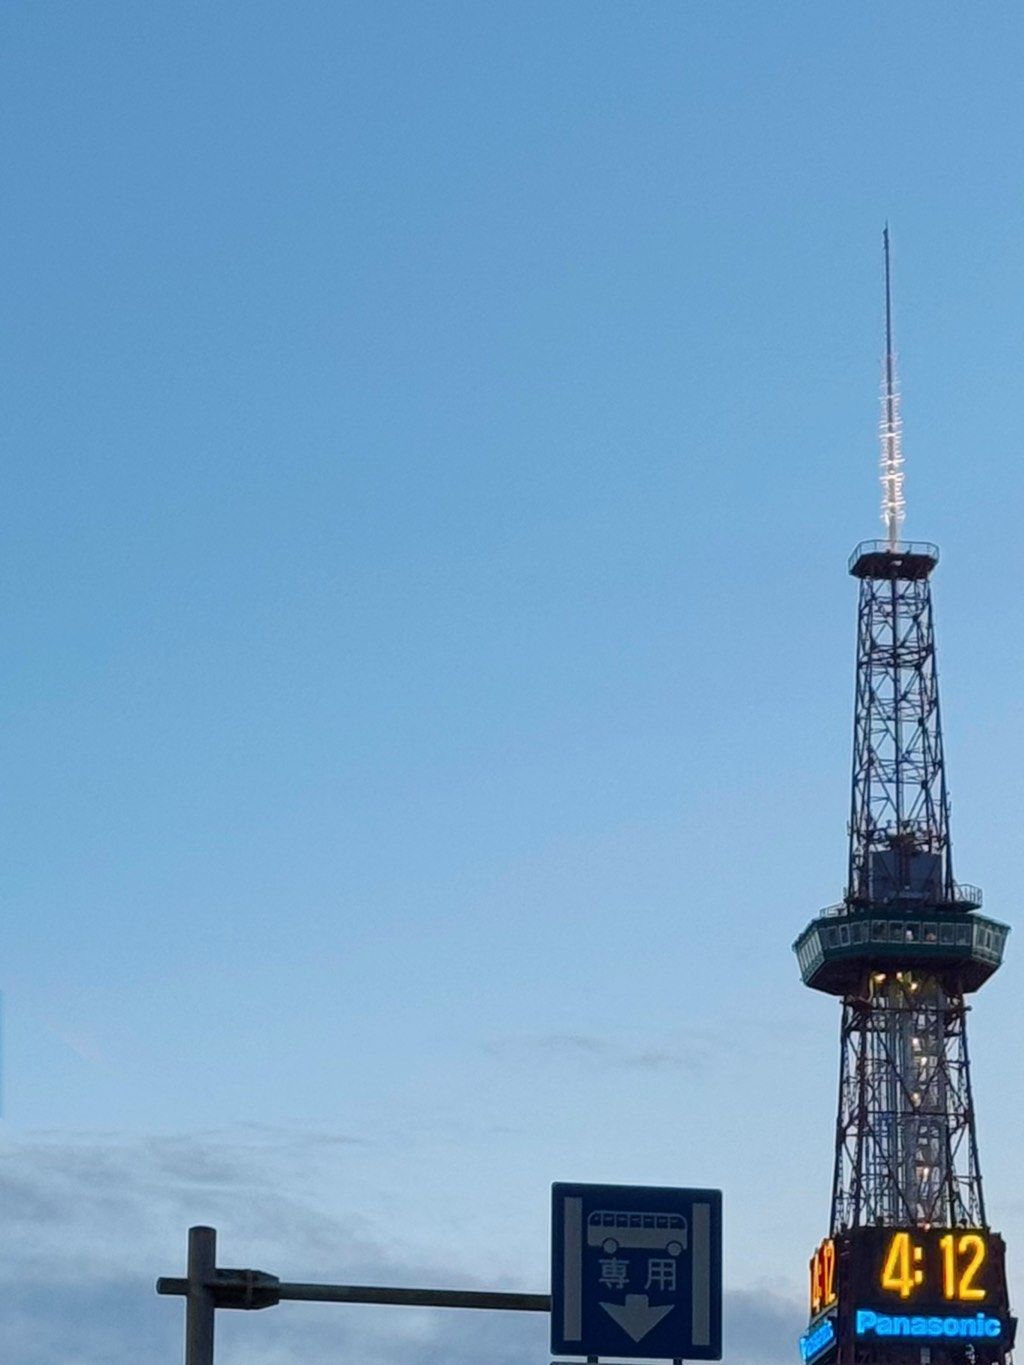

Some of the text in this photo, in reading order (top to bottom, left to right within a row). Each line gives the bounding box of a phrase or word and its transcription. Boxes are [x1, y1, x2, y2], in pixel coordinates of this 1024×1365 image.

[598, 1258, 676, 1291] 専用
[881, 1232, 986, 1300] 4:12
[856, 1309, 1001, 1337] Panasonic
